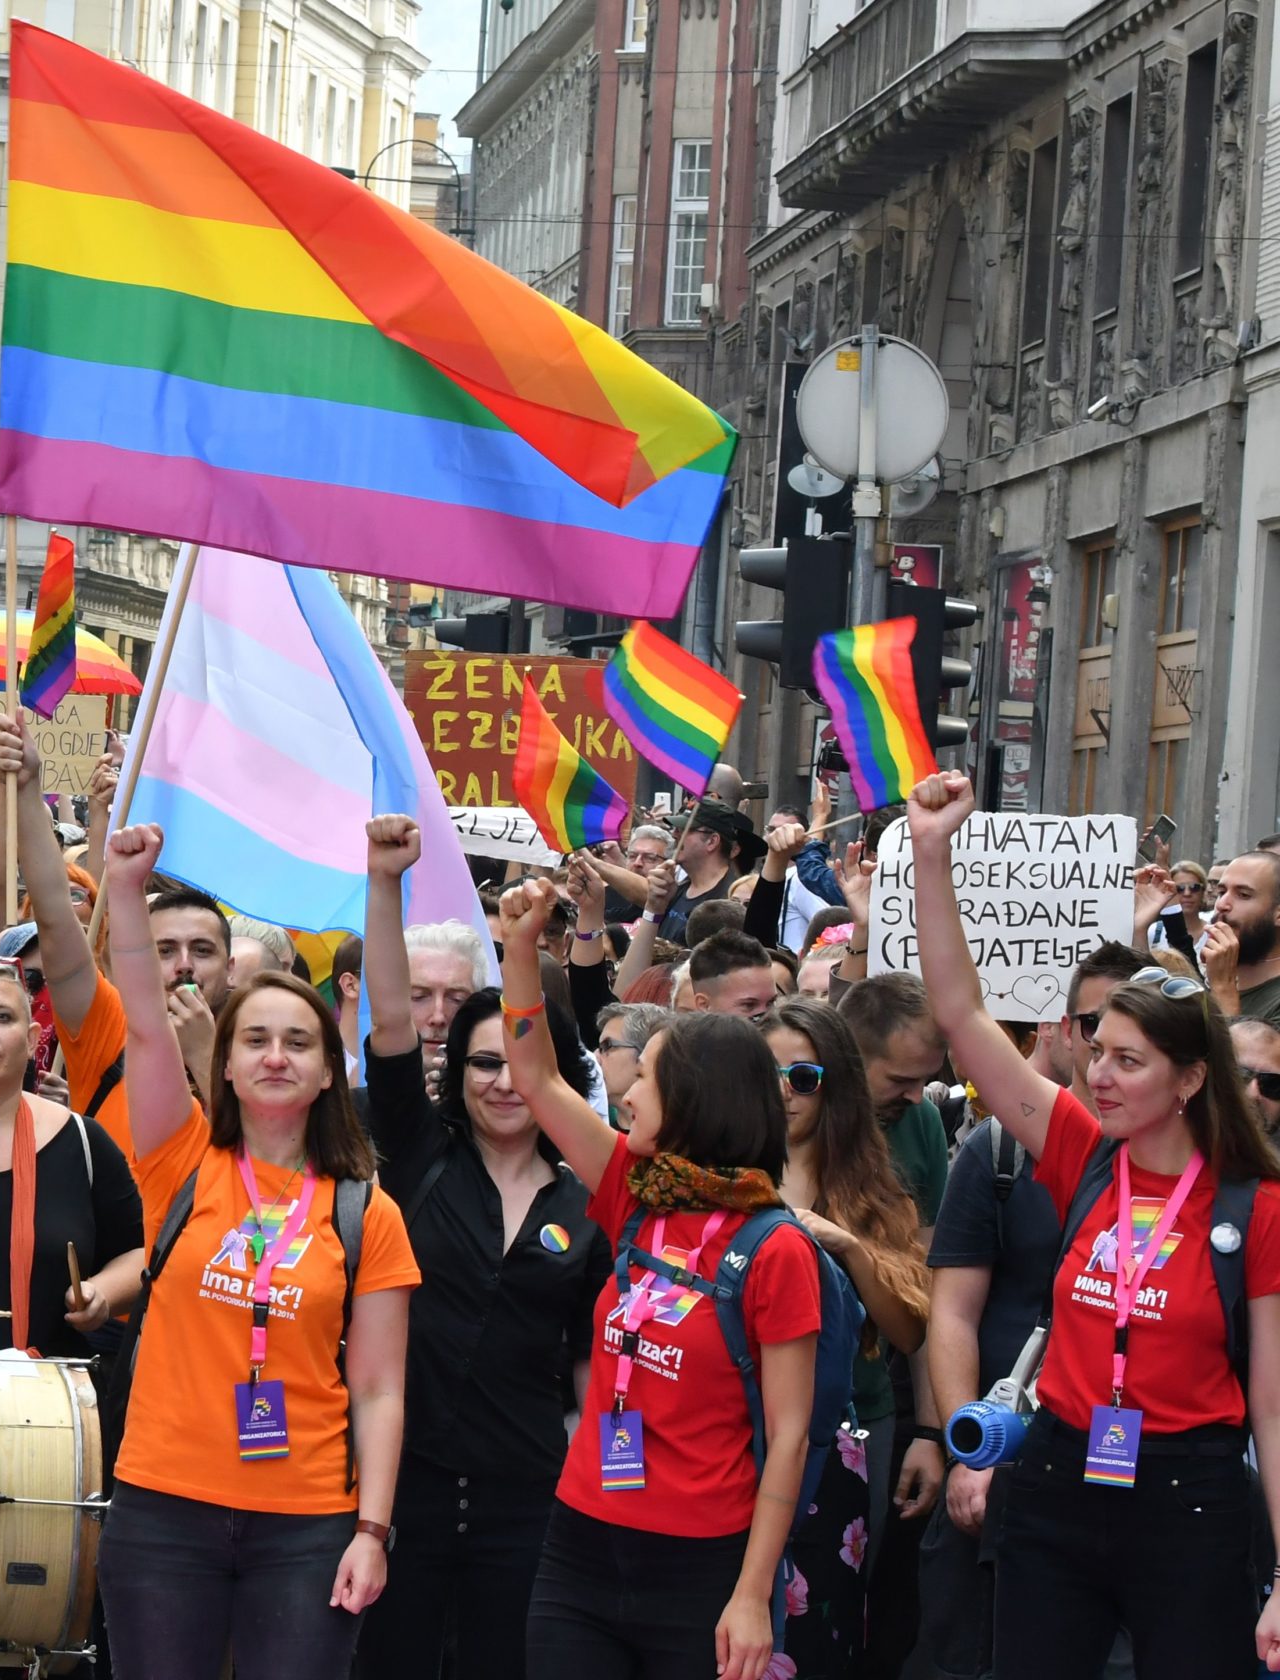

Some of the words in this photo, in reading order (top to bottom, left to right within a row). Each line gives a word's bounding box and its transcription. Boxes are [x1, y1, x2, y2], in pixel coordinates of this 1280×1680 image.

[423, 651, 567, 702] ŽENA
[59, 731, 102, 758] GDJE
[894, 818, 1119, 854] PIHVATAM
[879, 860, 1135, 890] HOOSEKSUALNE
[880, 896, 1099, 928] SURAĐANE
[201, 1264, 243, 1295] ima
[1074, 1274, 1112, 1297] има
[603, 1319, 624, 1346] im
